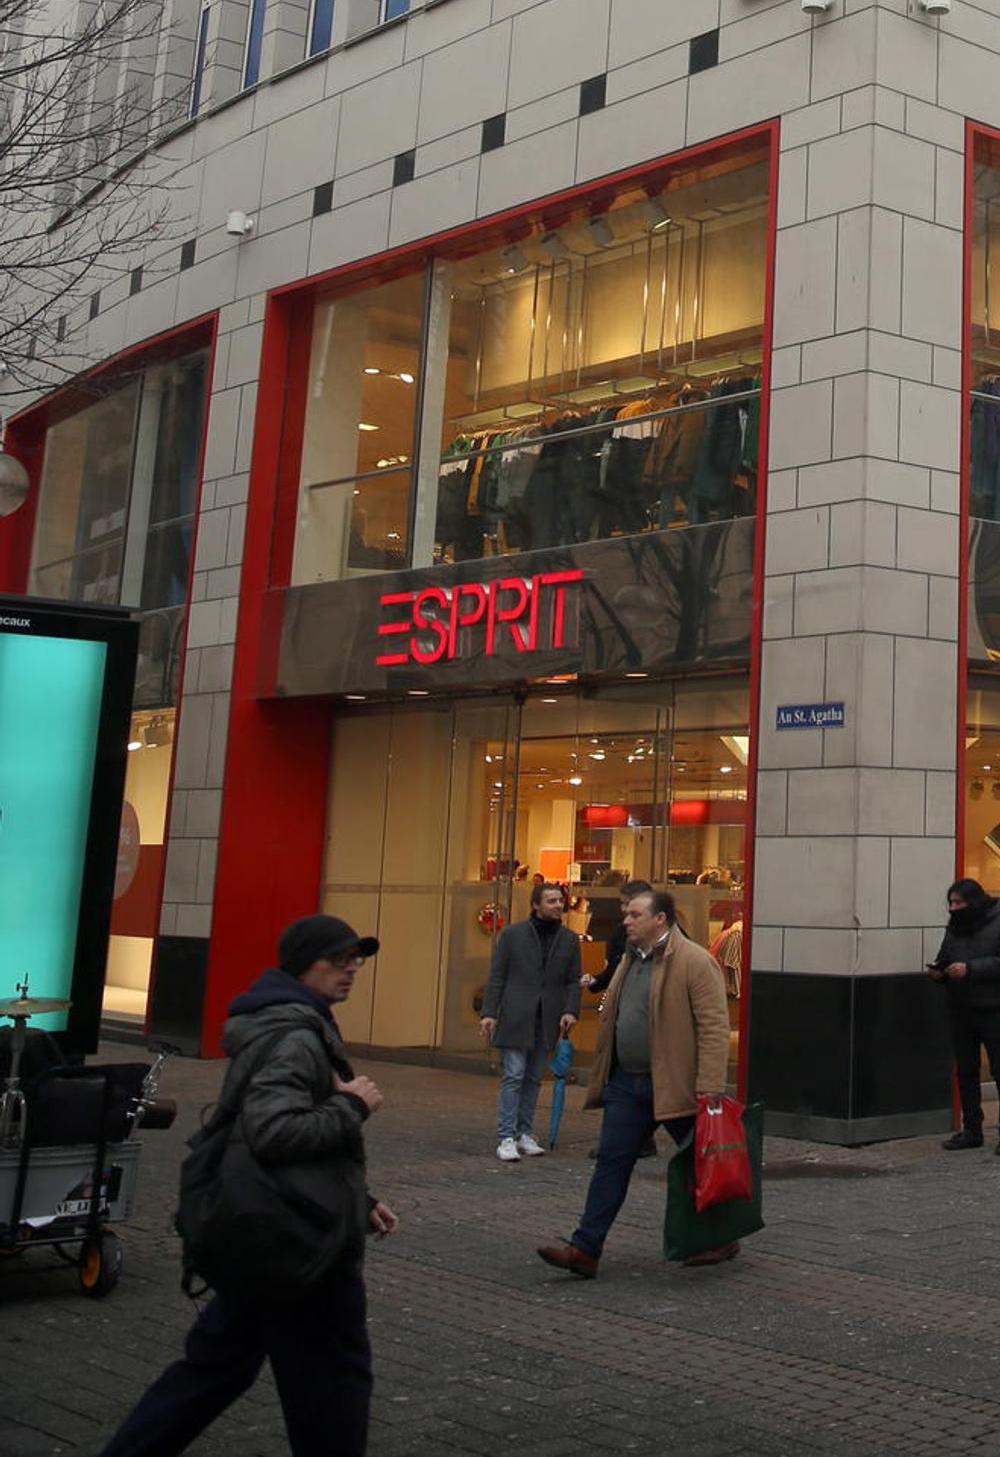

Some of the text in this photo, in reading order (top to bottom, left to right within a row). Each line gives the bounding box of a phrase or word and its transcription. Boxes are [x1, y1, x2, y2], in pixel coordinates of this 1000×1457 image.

[375, 568, 585, 666] ESPRIT
[778, 707, 843, 726] An St. Agatha
